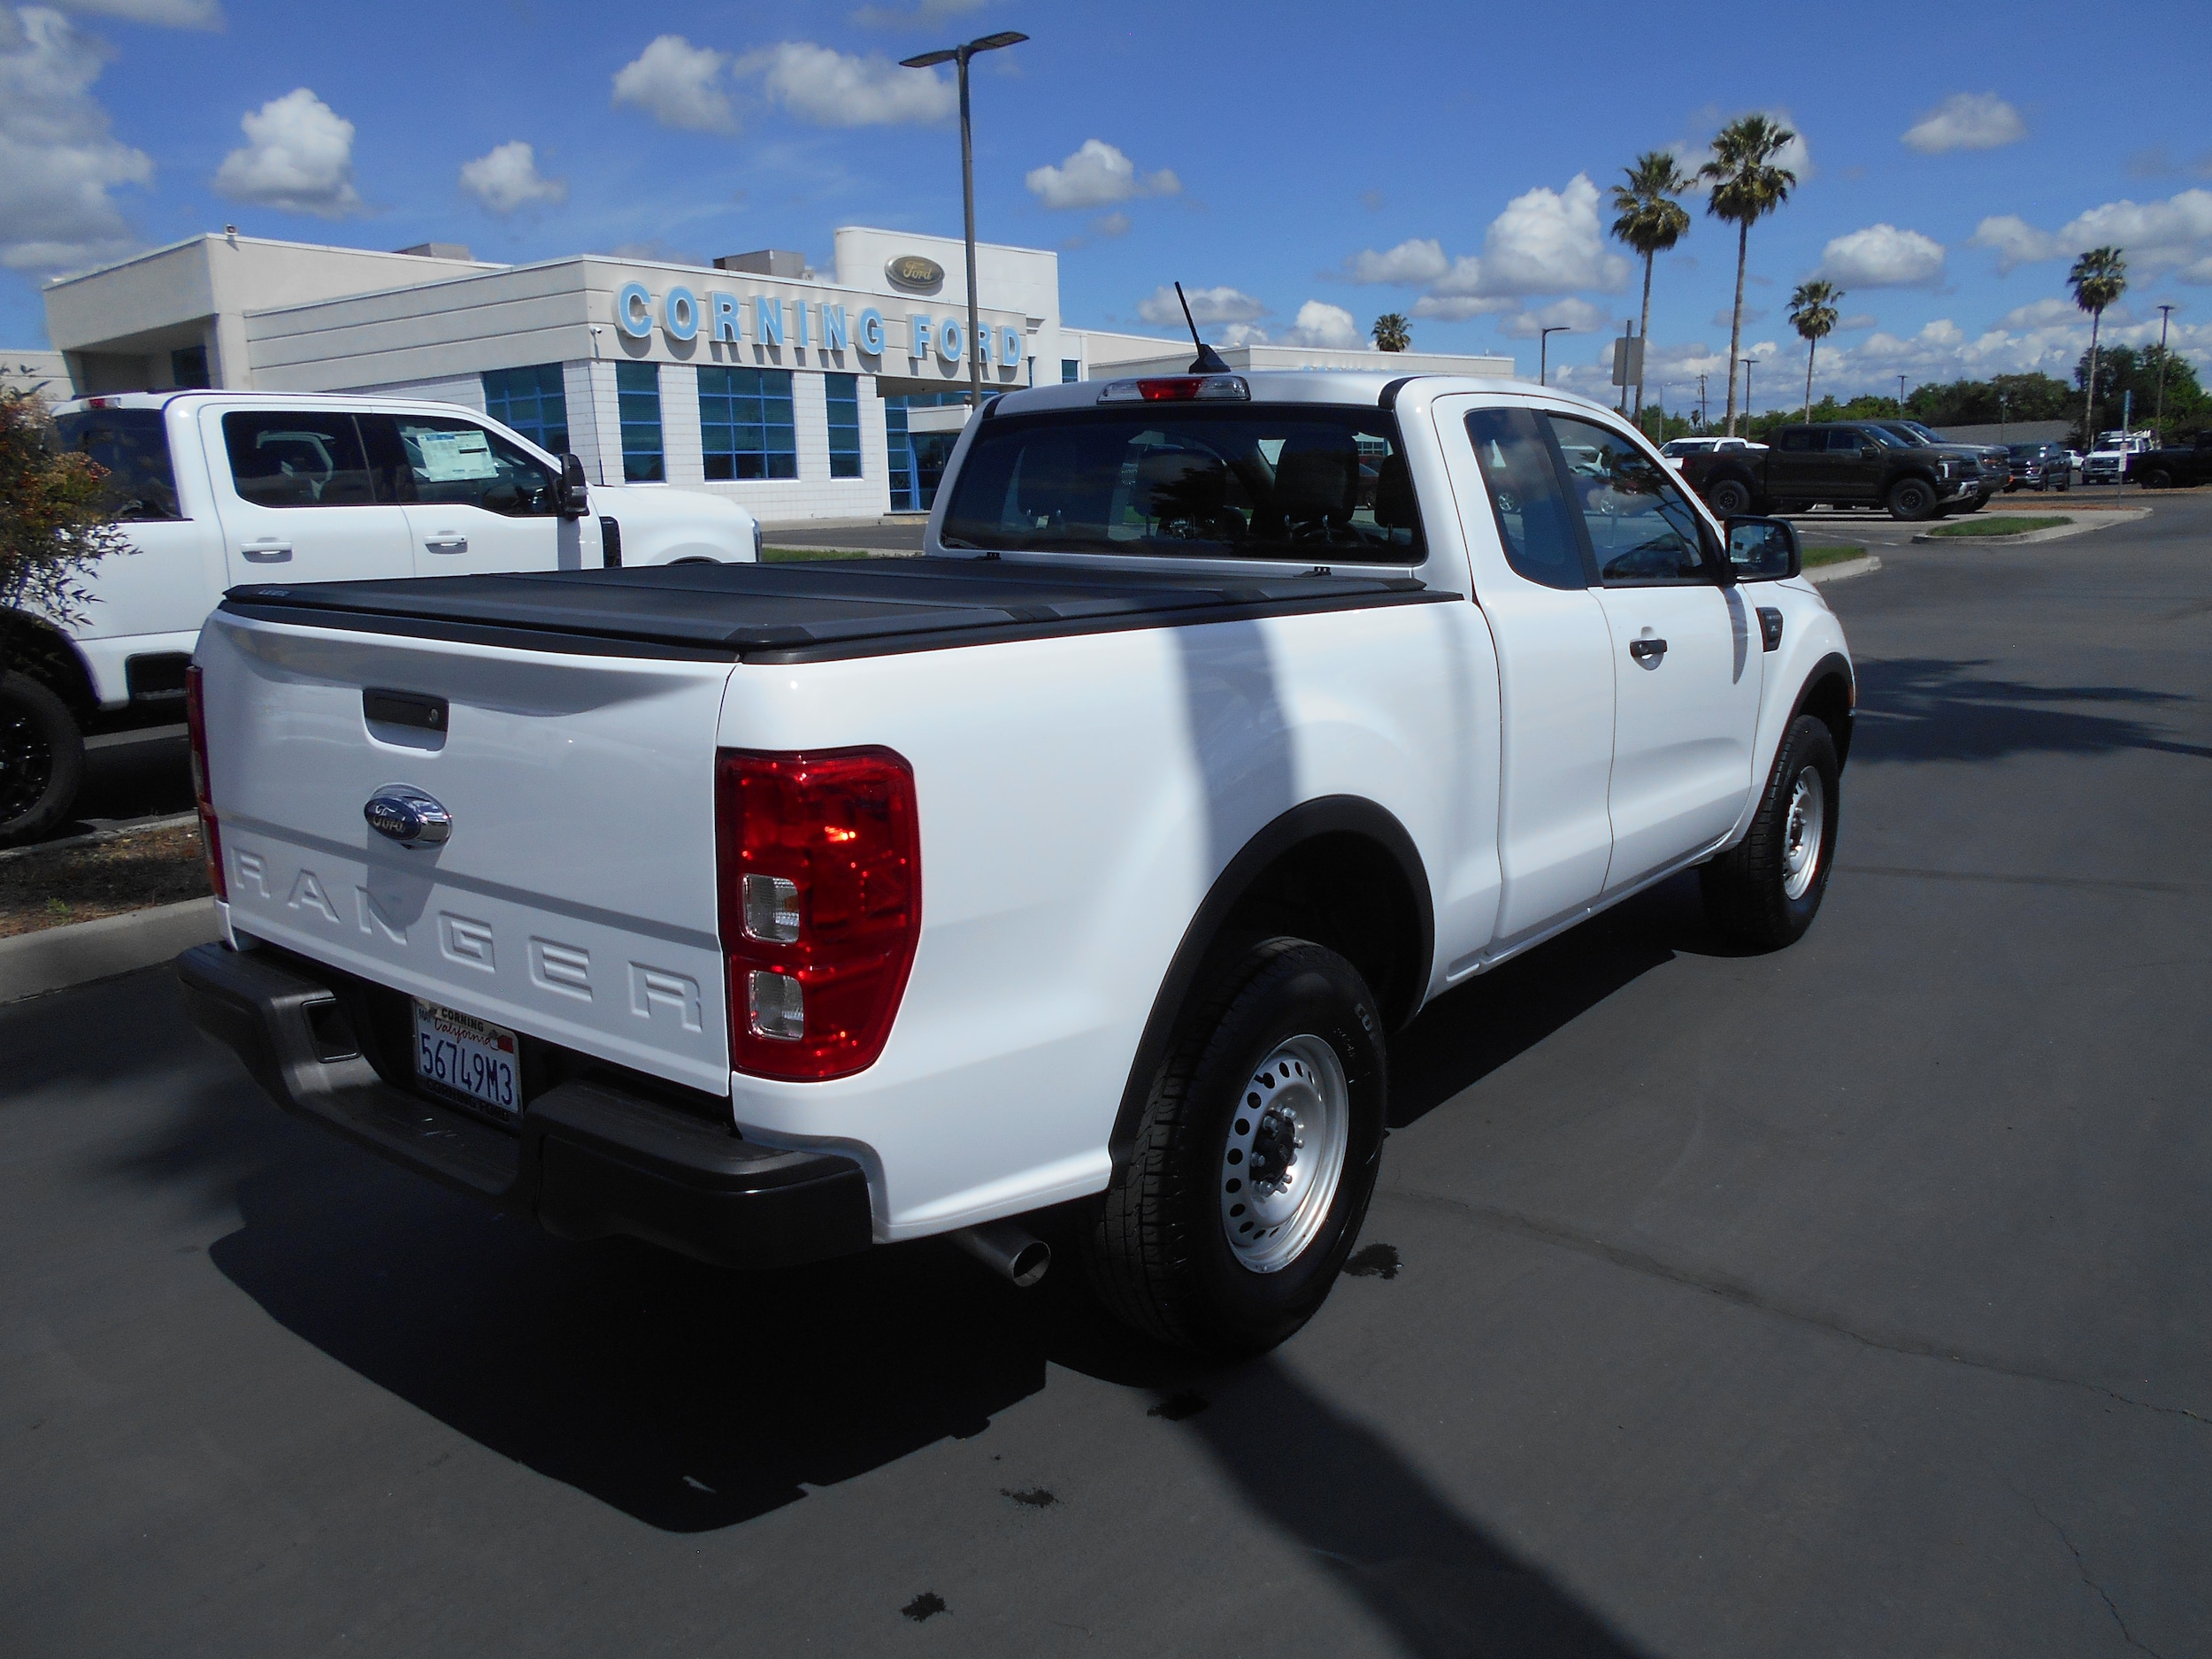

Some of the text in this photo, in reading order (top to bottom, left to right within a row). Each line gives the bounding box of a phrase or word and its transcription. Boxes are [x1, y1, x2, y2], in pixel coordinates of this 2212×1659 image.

[903, 258, 932, 280] Ford
[617, 280, 1021, 368] CORNING FORD
[373, 803, 407, 833] Ford
[231, 847, 703, 1033] RANGER
[434, 1018, 499, 1050] California
[442, 1007, 484, 1032] CORNING
[421, 1033, 513, 1105] 56749M3
